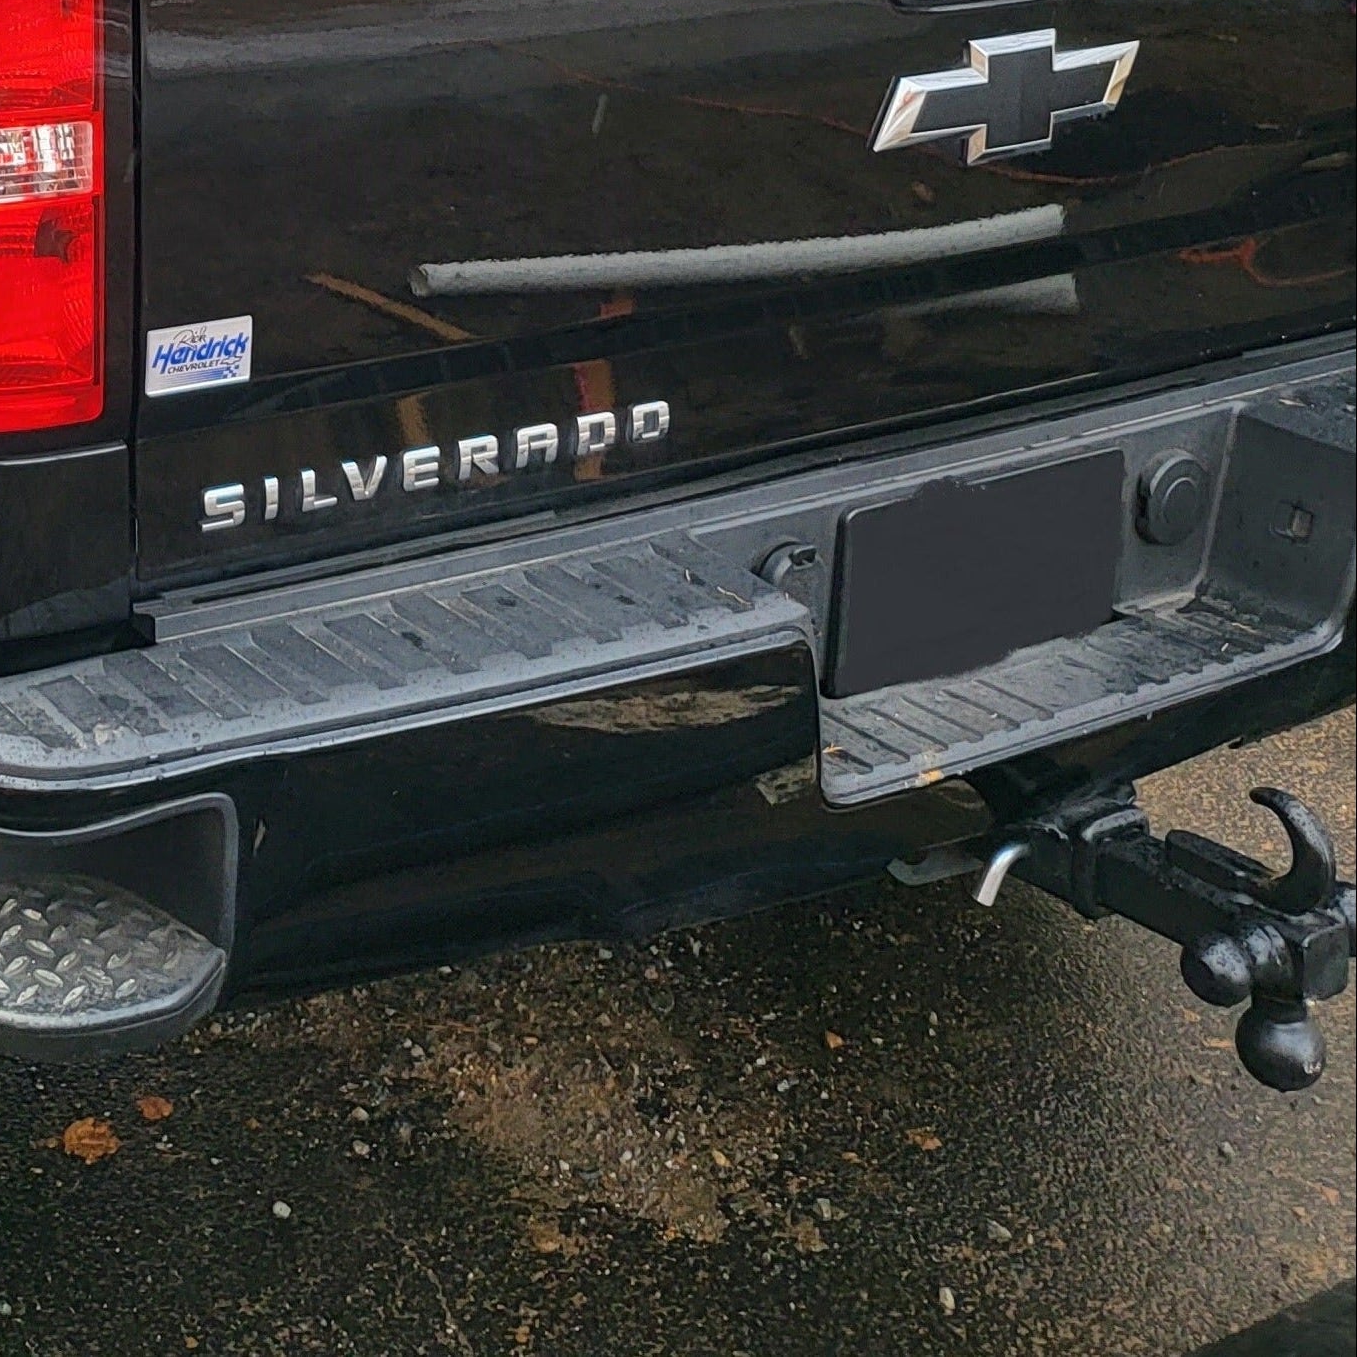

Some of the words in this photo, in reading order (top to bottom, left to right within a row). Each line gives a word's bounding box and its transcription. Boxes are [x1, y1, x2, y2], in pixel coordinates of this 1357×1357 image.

[152, 332, 250, 374] Hendrick
[173, 326, 207, 350] Rick
[167, 358, 221, 374] CHEVROLET
[200, 400, 671, 532] SILVERADO
